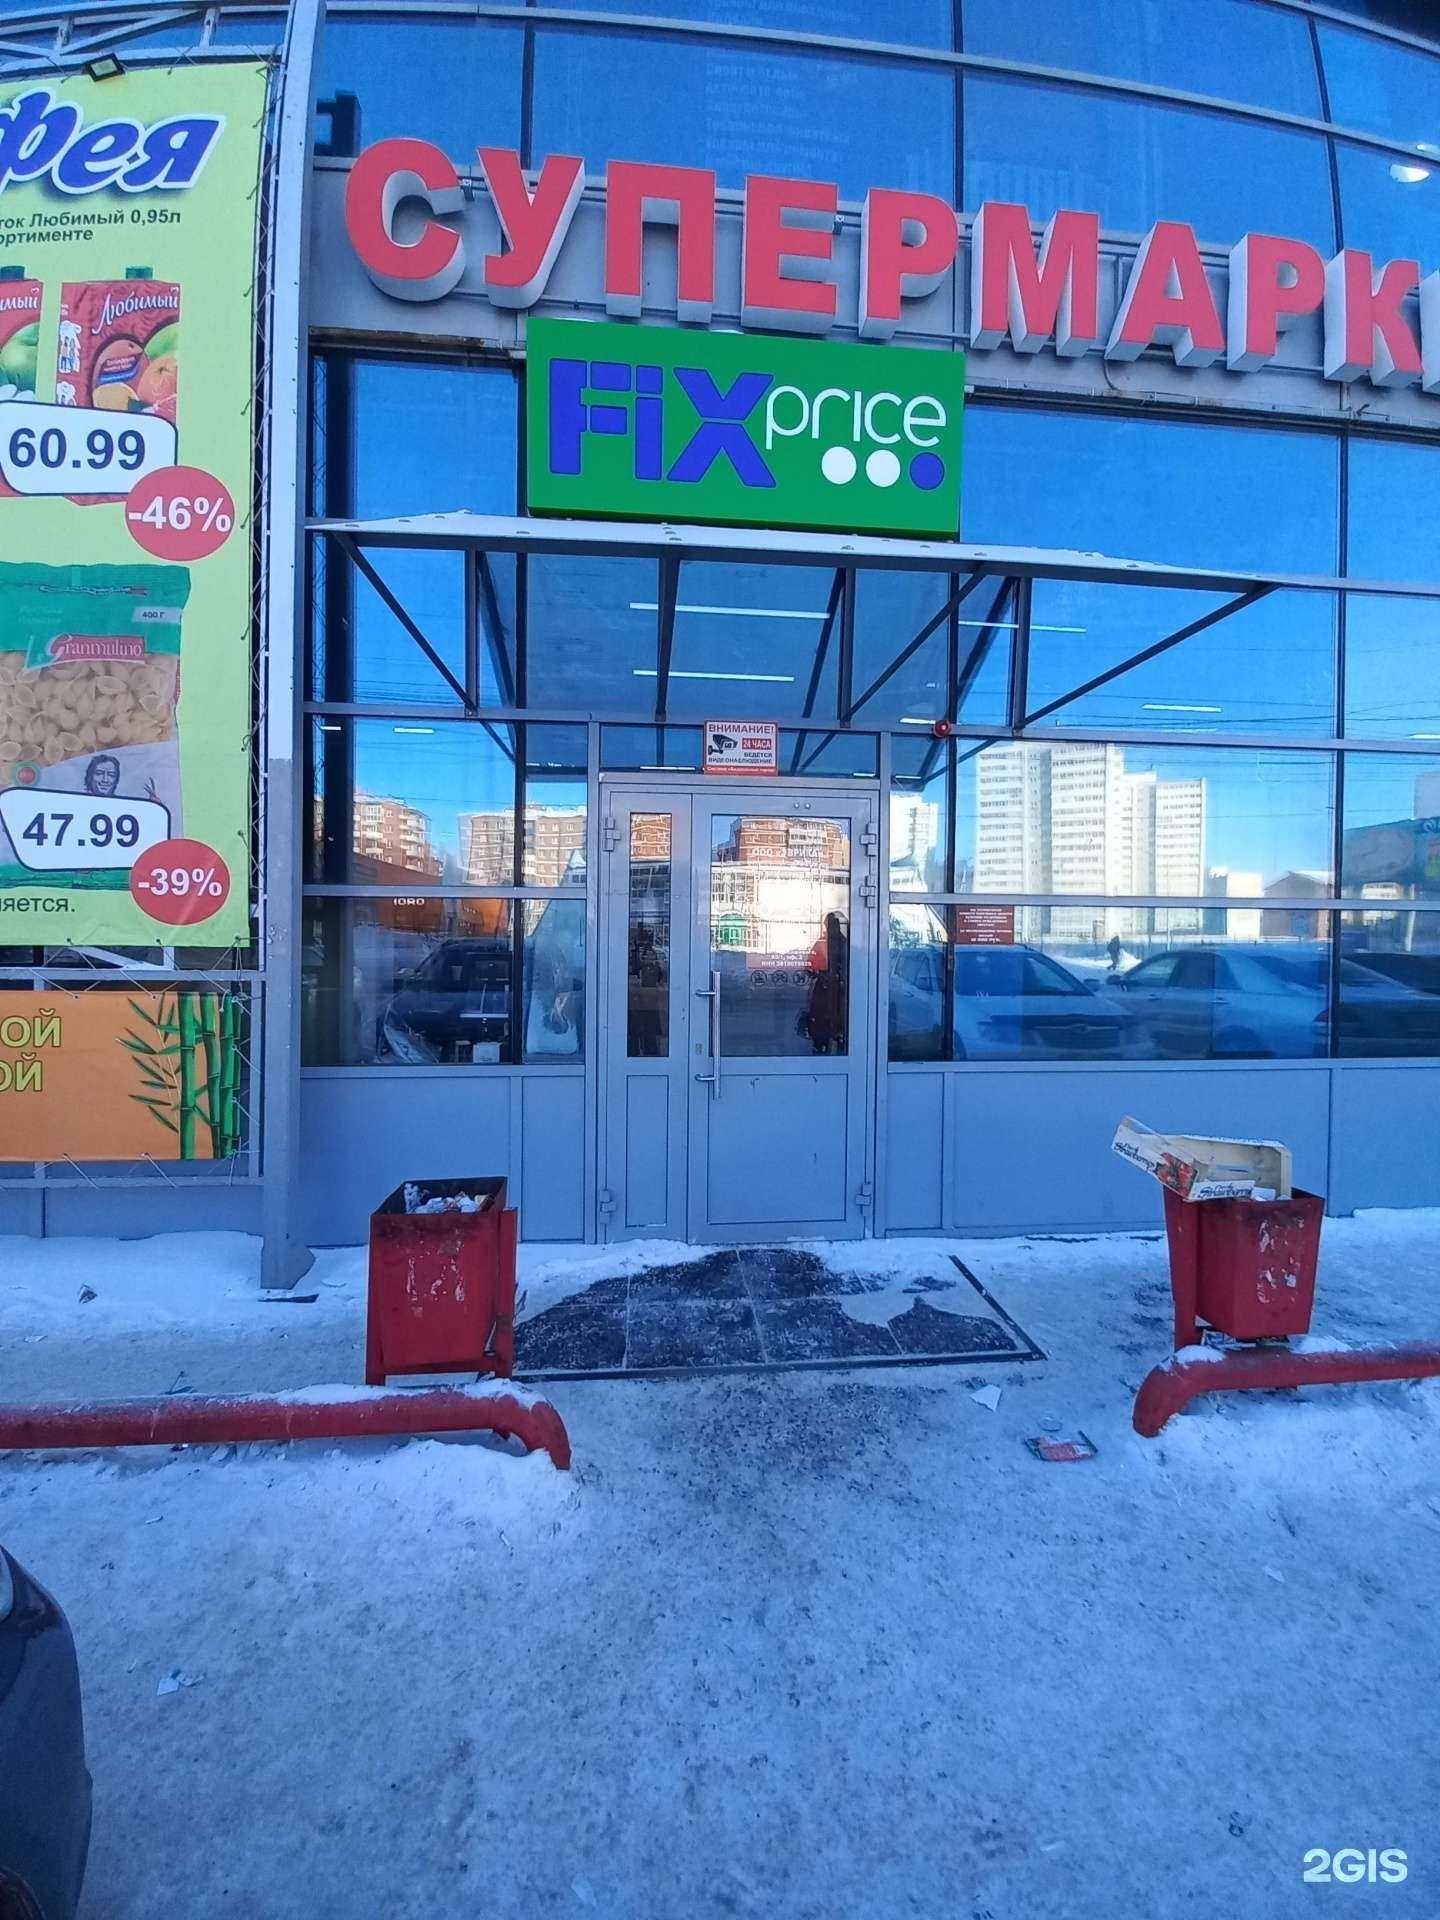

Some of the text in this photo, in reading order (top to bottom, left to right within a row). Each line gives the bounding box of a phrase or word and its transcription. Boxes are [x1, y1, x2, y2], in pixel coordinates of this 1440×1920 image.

[29, 209, 125, 228] Любимый
[131, 209, 181, 226] 0,95л
[345, 138, 1440, 393] СУПЕРМАРК
[91, 287, 179, 334] Любимый
[766, 385, 948, 450] price
[9, 428, 146, 470] 60.99
[128, 496, 231, 532] -46%
[708, 724, 774, 734] ВНИМАНИЕ!
[743, 739, 771, 748] 24 ЧАСА
[22, 813, 140, 847] 47.99
[138, 868, 222, 896] -39%
[0, 897, 76, 913] яется.
